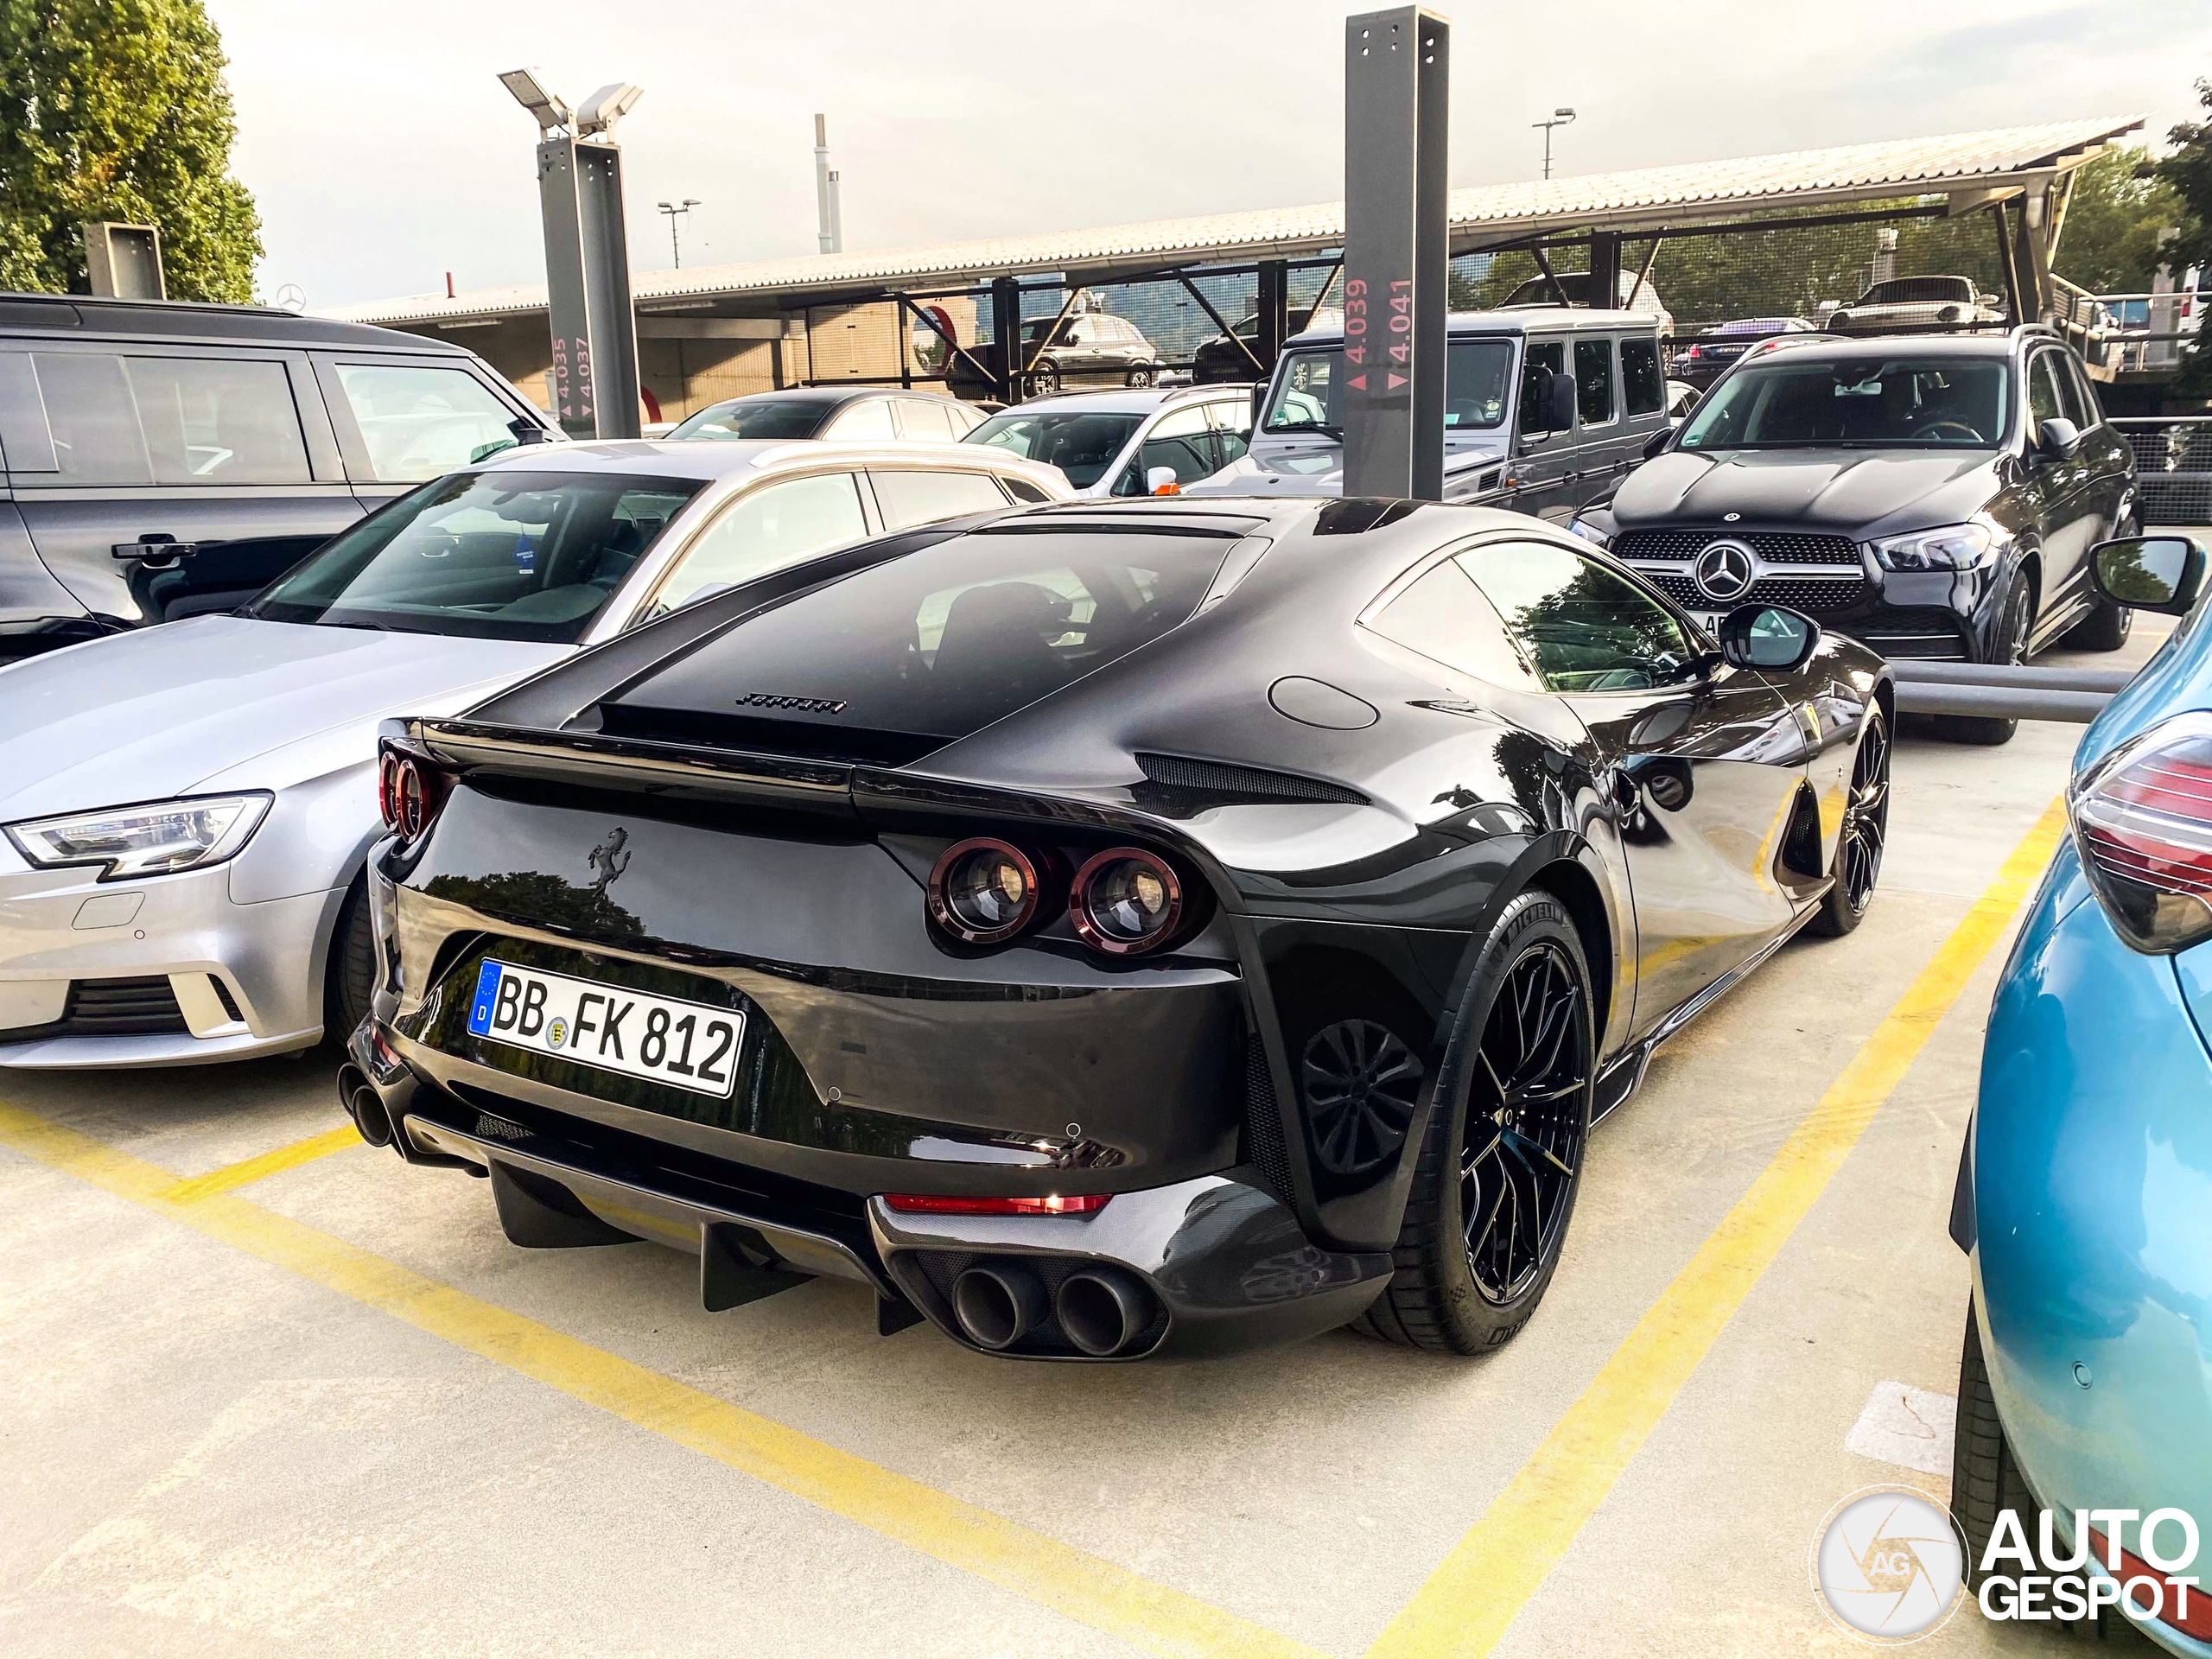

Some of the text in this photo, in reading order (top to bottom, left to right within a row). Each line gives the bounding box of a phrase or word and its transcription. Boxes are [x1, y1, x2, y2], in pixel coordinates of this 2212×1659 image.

[1345, 279, 1367, 364] 4.039
[1389, 280, 1411, 361] 4.041
[554, 338, 569, 398] 4.035
[575, 337, 591, 397] 4.037
[1504, 902, 1564, 948] MICHELIN
[477, 1005, 486, 1021] D
[493, 974, 548, 1037] BB
[570, 992, 635, 1061] FK
[639, 1007, 734, 1084] 812
